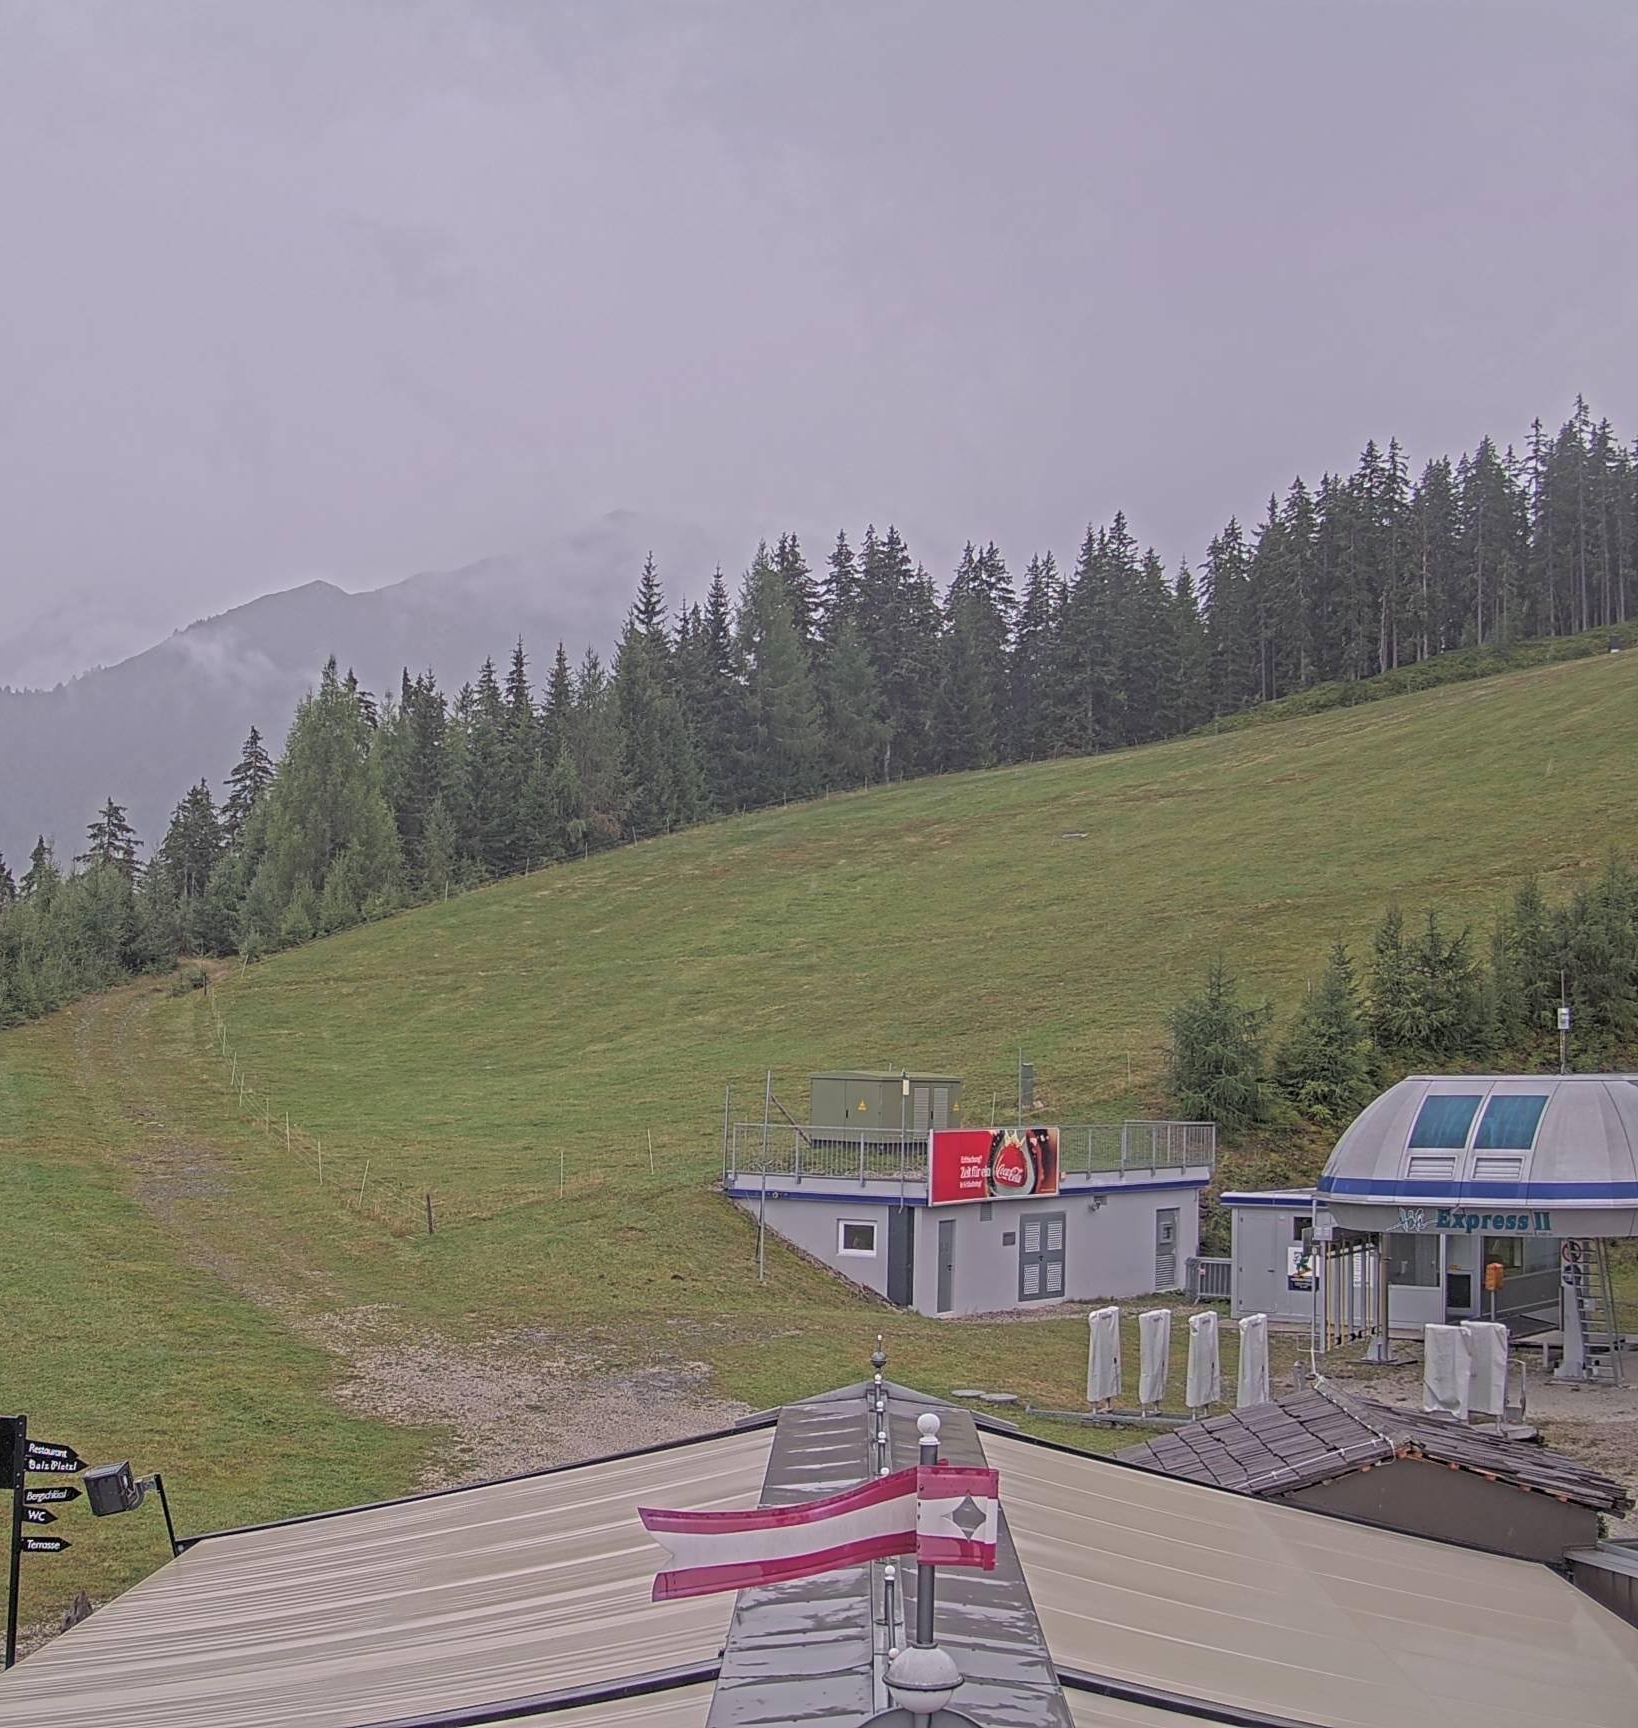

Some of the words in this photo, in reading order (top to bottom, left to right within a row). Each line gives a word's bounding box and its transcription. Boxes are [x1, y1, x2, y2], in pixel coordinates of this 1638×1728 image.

[1436, 1208, 1529, 1233] Express
[1534, 1211, 1551, 1231] II
[28, 1443, 68, 1458] Restaurant
[28, 1510, 46, 1521] WC
[27, 1540, 60, 1550] Terrasse
